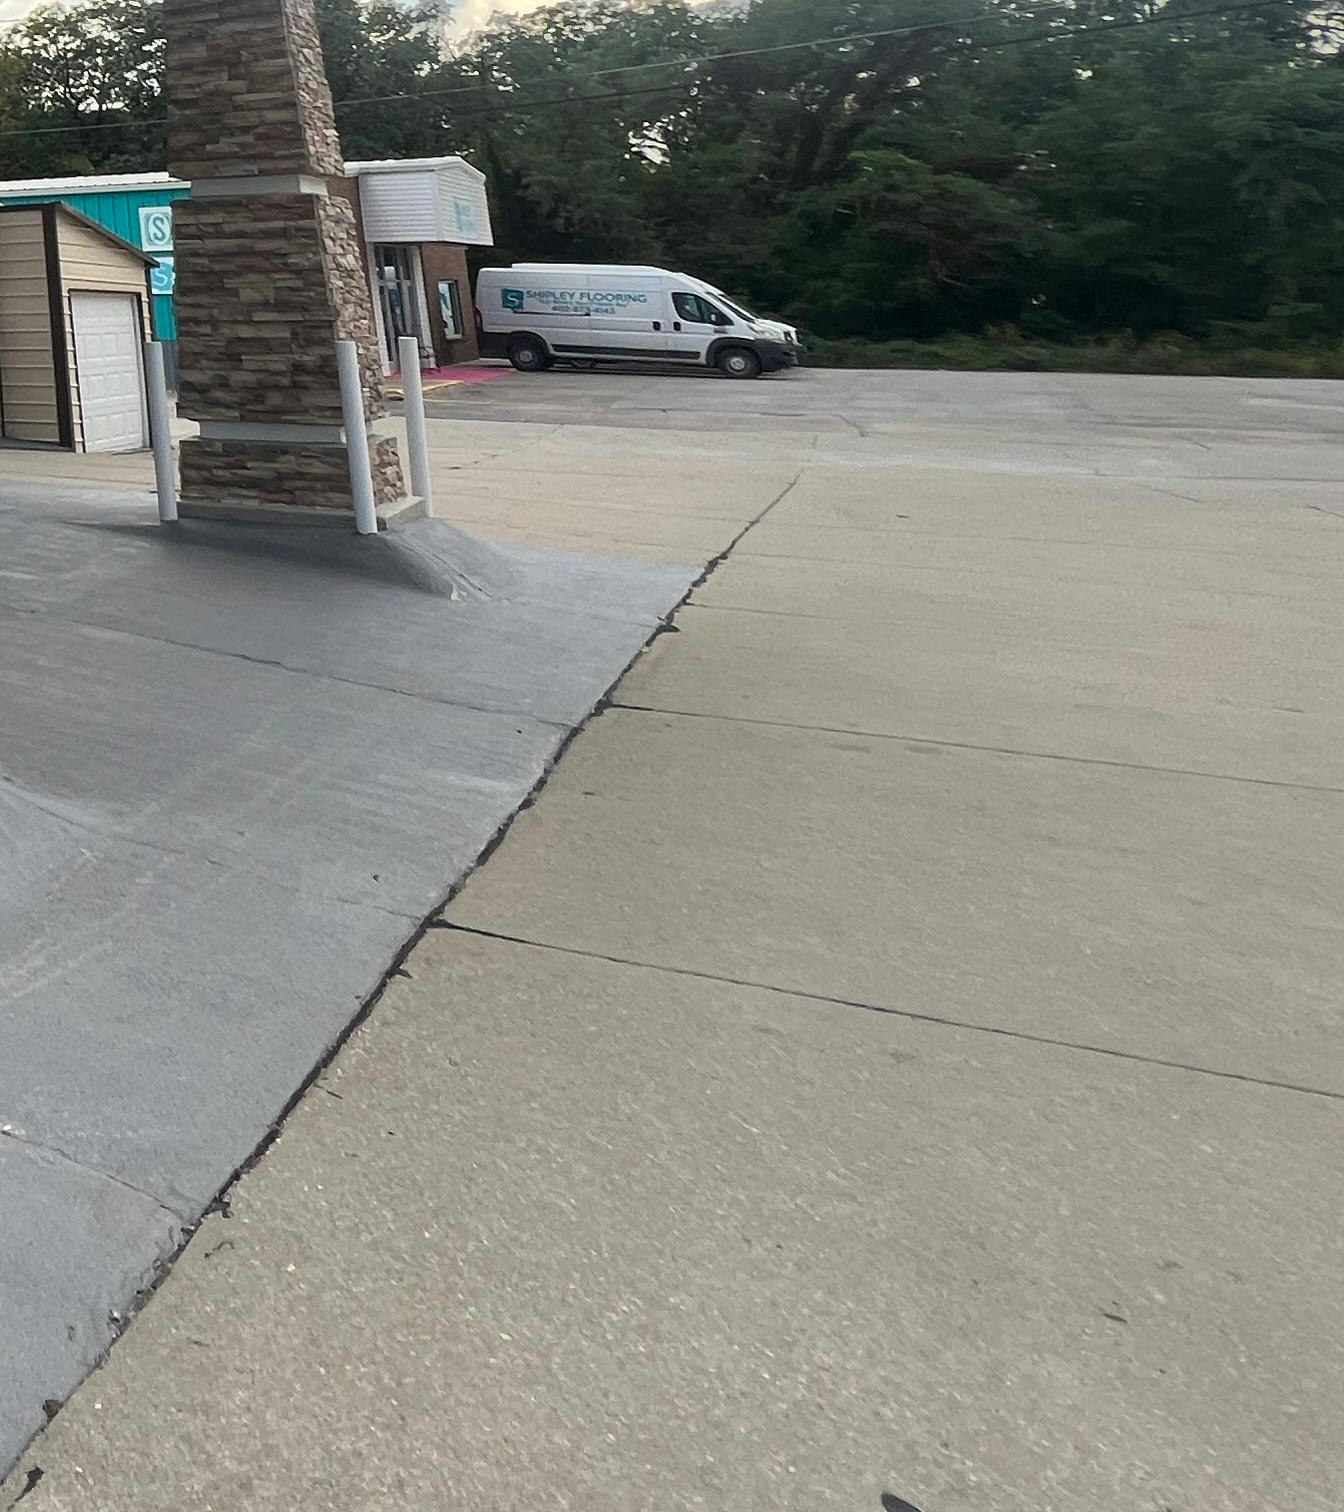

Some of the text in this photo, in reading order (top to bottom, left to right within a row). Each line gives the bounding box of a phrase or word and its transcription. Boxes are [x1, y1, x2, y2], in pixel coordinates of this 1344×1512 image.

[153, 216, 166, 242] S
[525, 290, 576, 302] SHIPLEY
[579, 291, 648, 304] FLOORING
